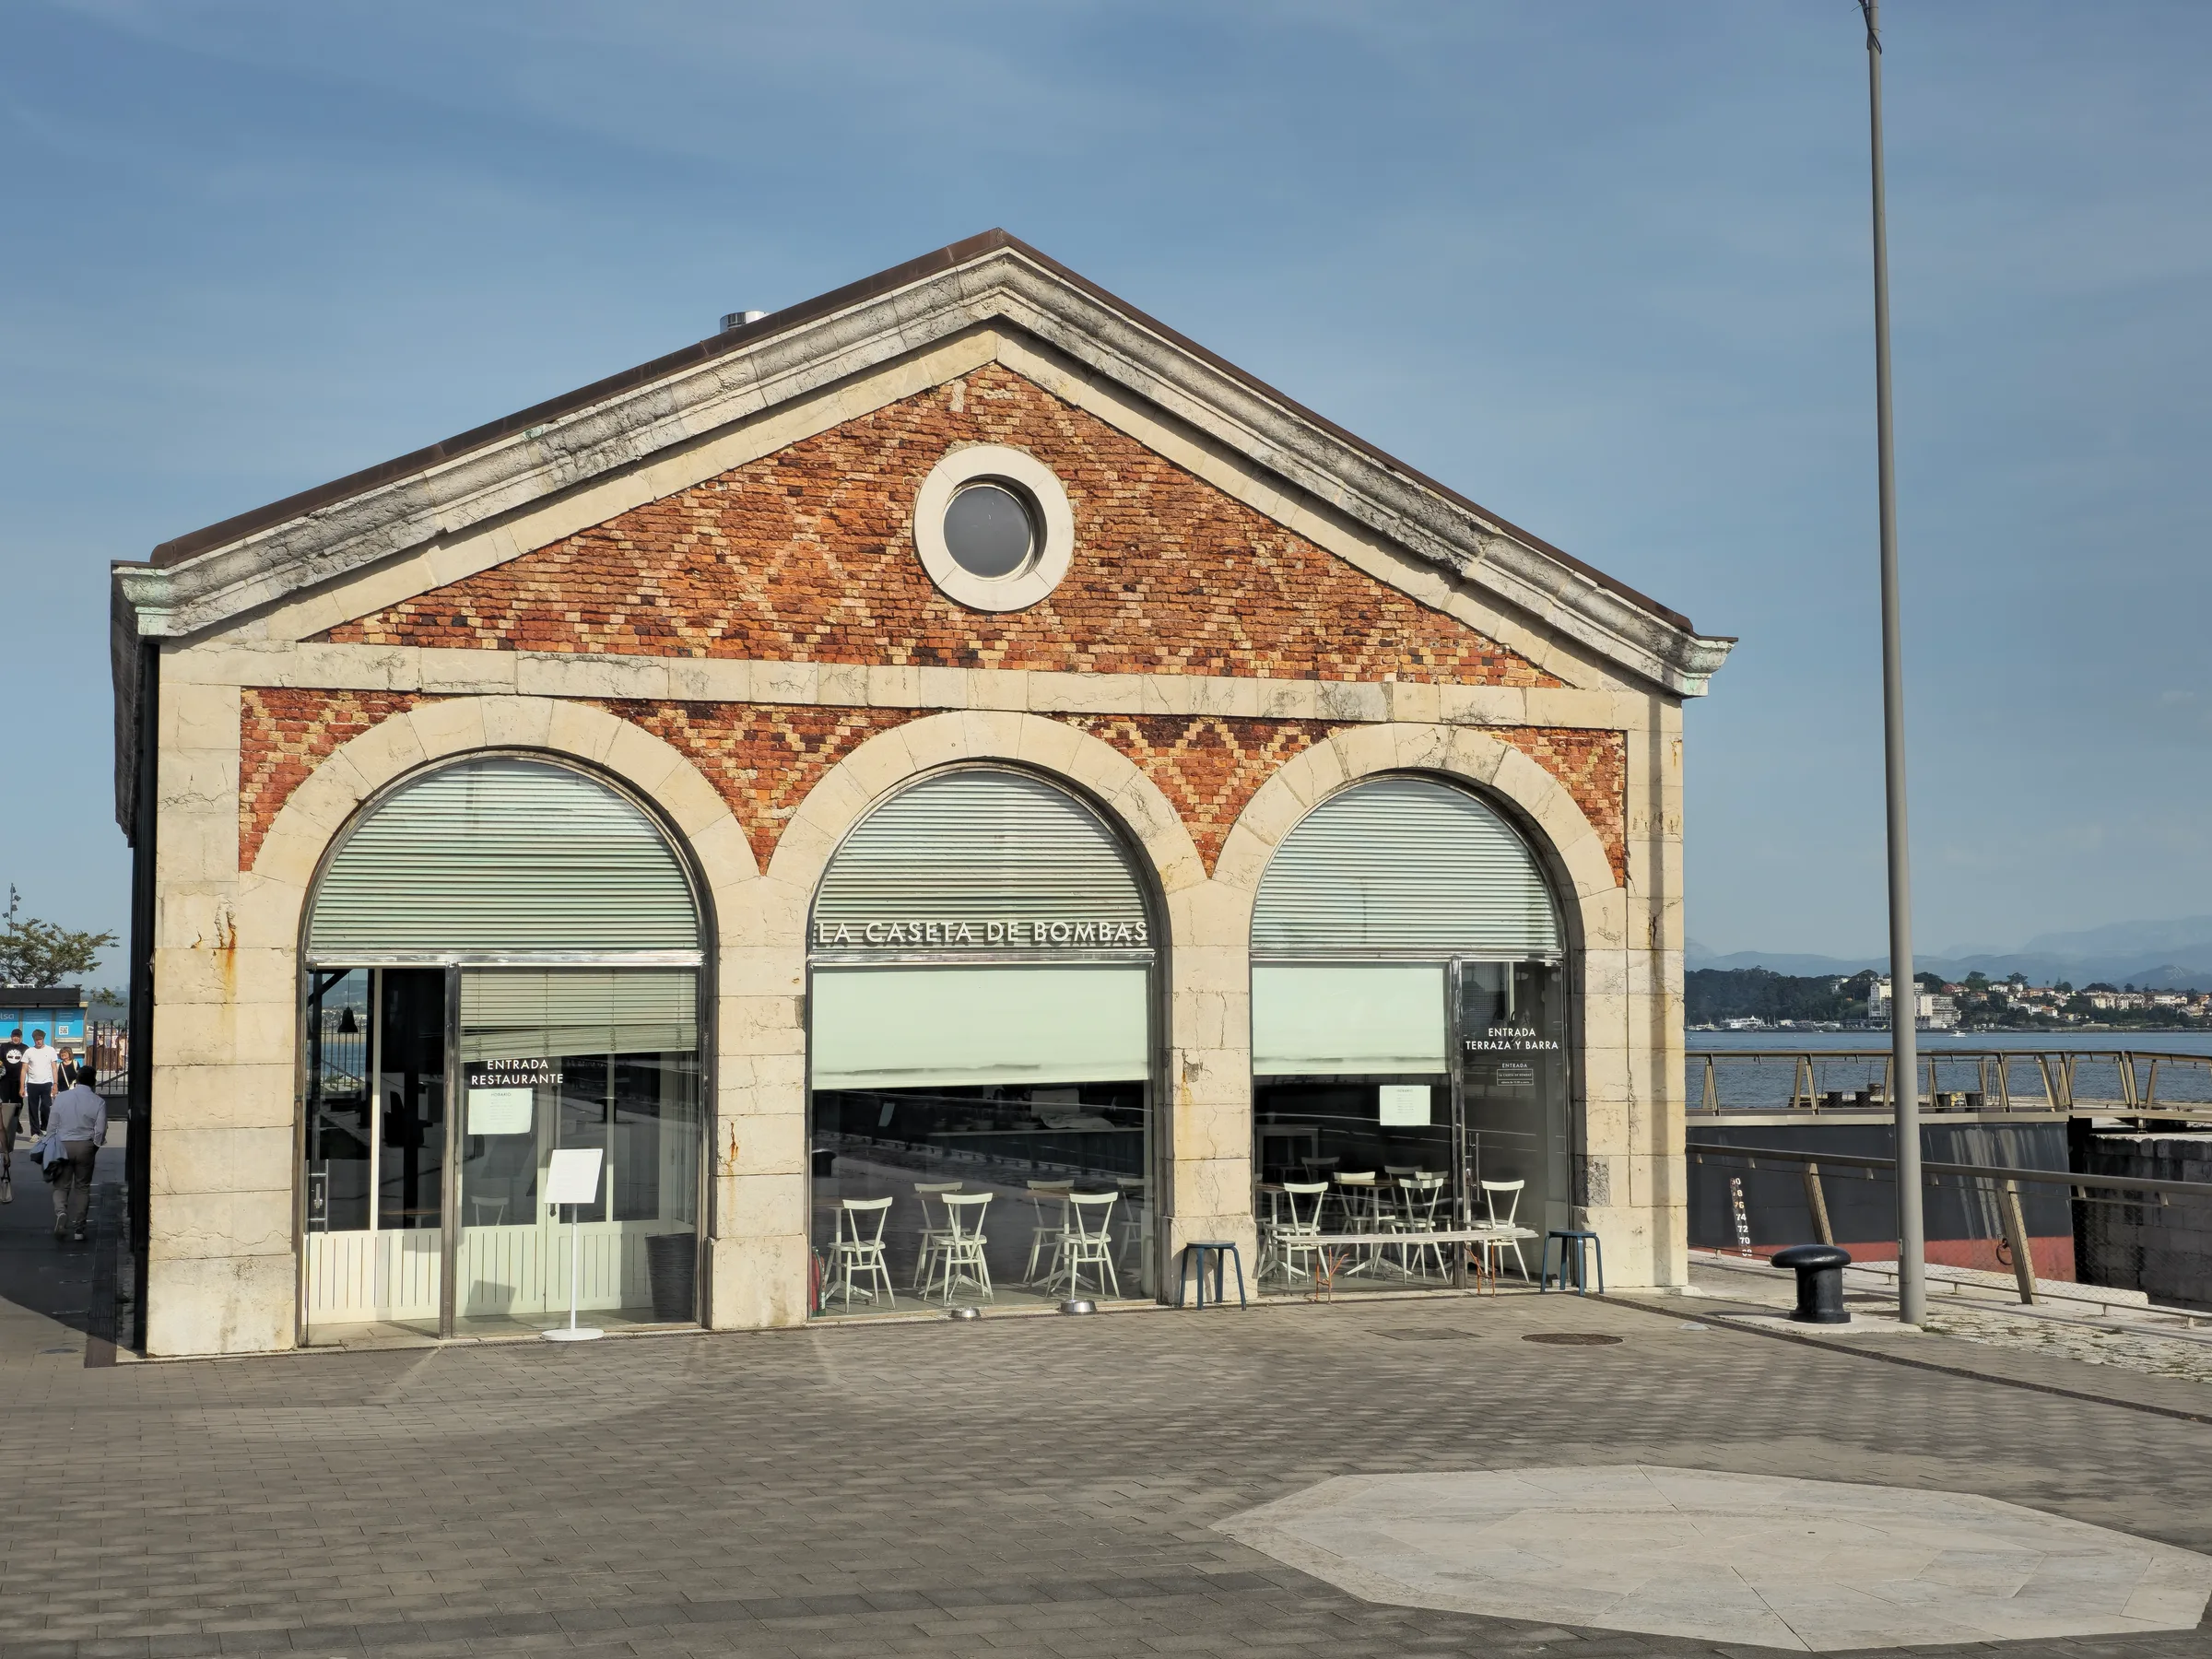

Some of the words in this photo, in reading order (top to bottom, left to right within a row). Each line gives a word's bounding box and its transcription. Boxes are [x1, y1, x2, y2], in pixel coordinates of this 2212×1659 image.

[818, 922, 851, 943] LA
[865, 922, 972, 943] CASETA
[986, 922, 1018, 942] DE
[1033, 921, 1147, 943] BOMBAS
[1488, 1028, 1536, 1037] ENTRADA
[1465, 1041, 1511, 1050] TERRAZA
[1514, 1041, 1521, 1050] Y
[1525, 1041, 1559, 1050] BARRA
[487, 1059, 549, 1070] ENTRADA
[471, 1074, 564, 1086] RESTAURANTE
[1734, 1201, 1745, 1209] 76
[1735, 1213, 1747, 1221] 74
[1737, 1225, 1748, 1233] 72
